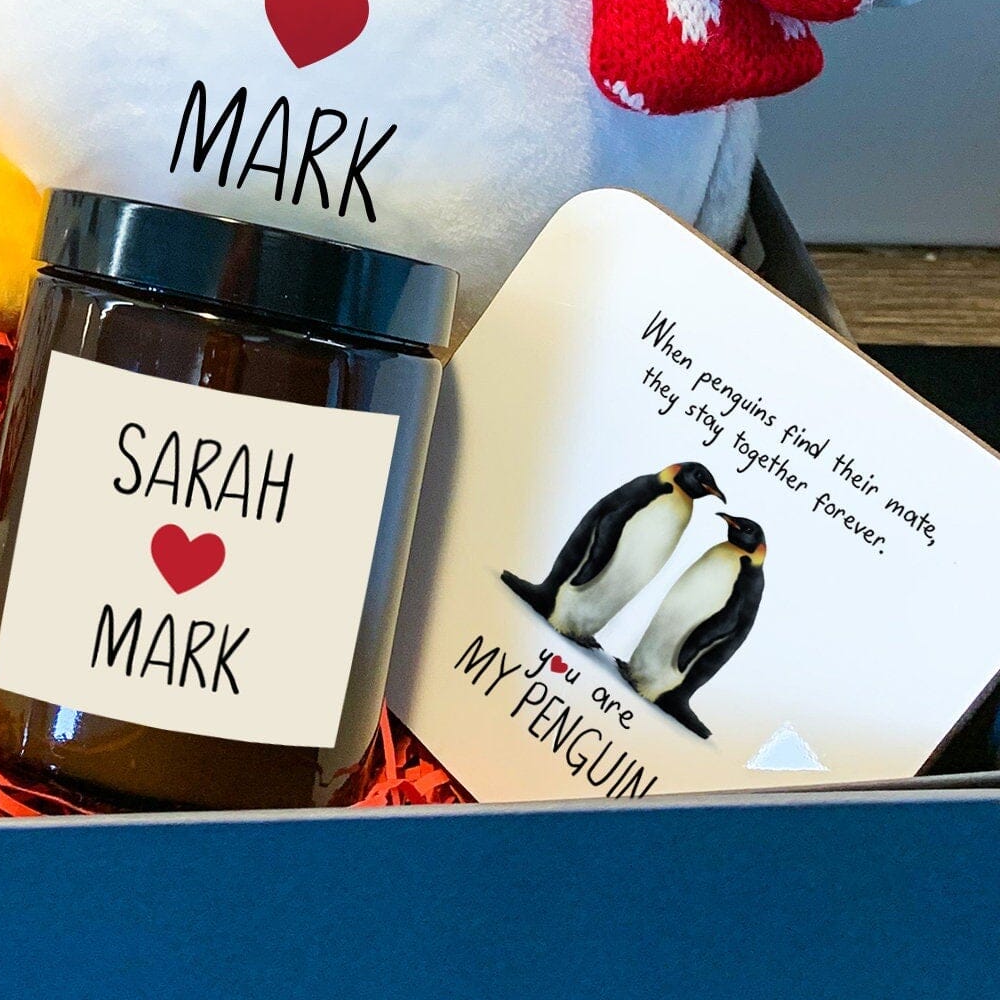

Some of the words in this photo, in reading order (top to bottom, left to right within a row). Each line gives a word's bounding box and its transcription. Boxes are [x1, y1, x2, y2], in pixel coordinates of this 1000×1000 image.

[169, 79, 398, 224] MARK
[112, 421, 295, 524] SARAH
[640, 309, 693, 371] When
[690, 370, 777, 428] penguins
[779, 427, 831, 460] find
[831, 453, 879, 497] their
[884, 497, 937, 548] mate,
[641, 366, 680, 416] they
[684, 403, 725, 448] stay
[732, 430, 809, 493] together
[811, 492, 886, 556] forever.
[90, 603, 251, 696] MARK
[453, 634, 523, 697] MY
[591, 686, 635, 730] are
